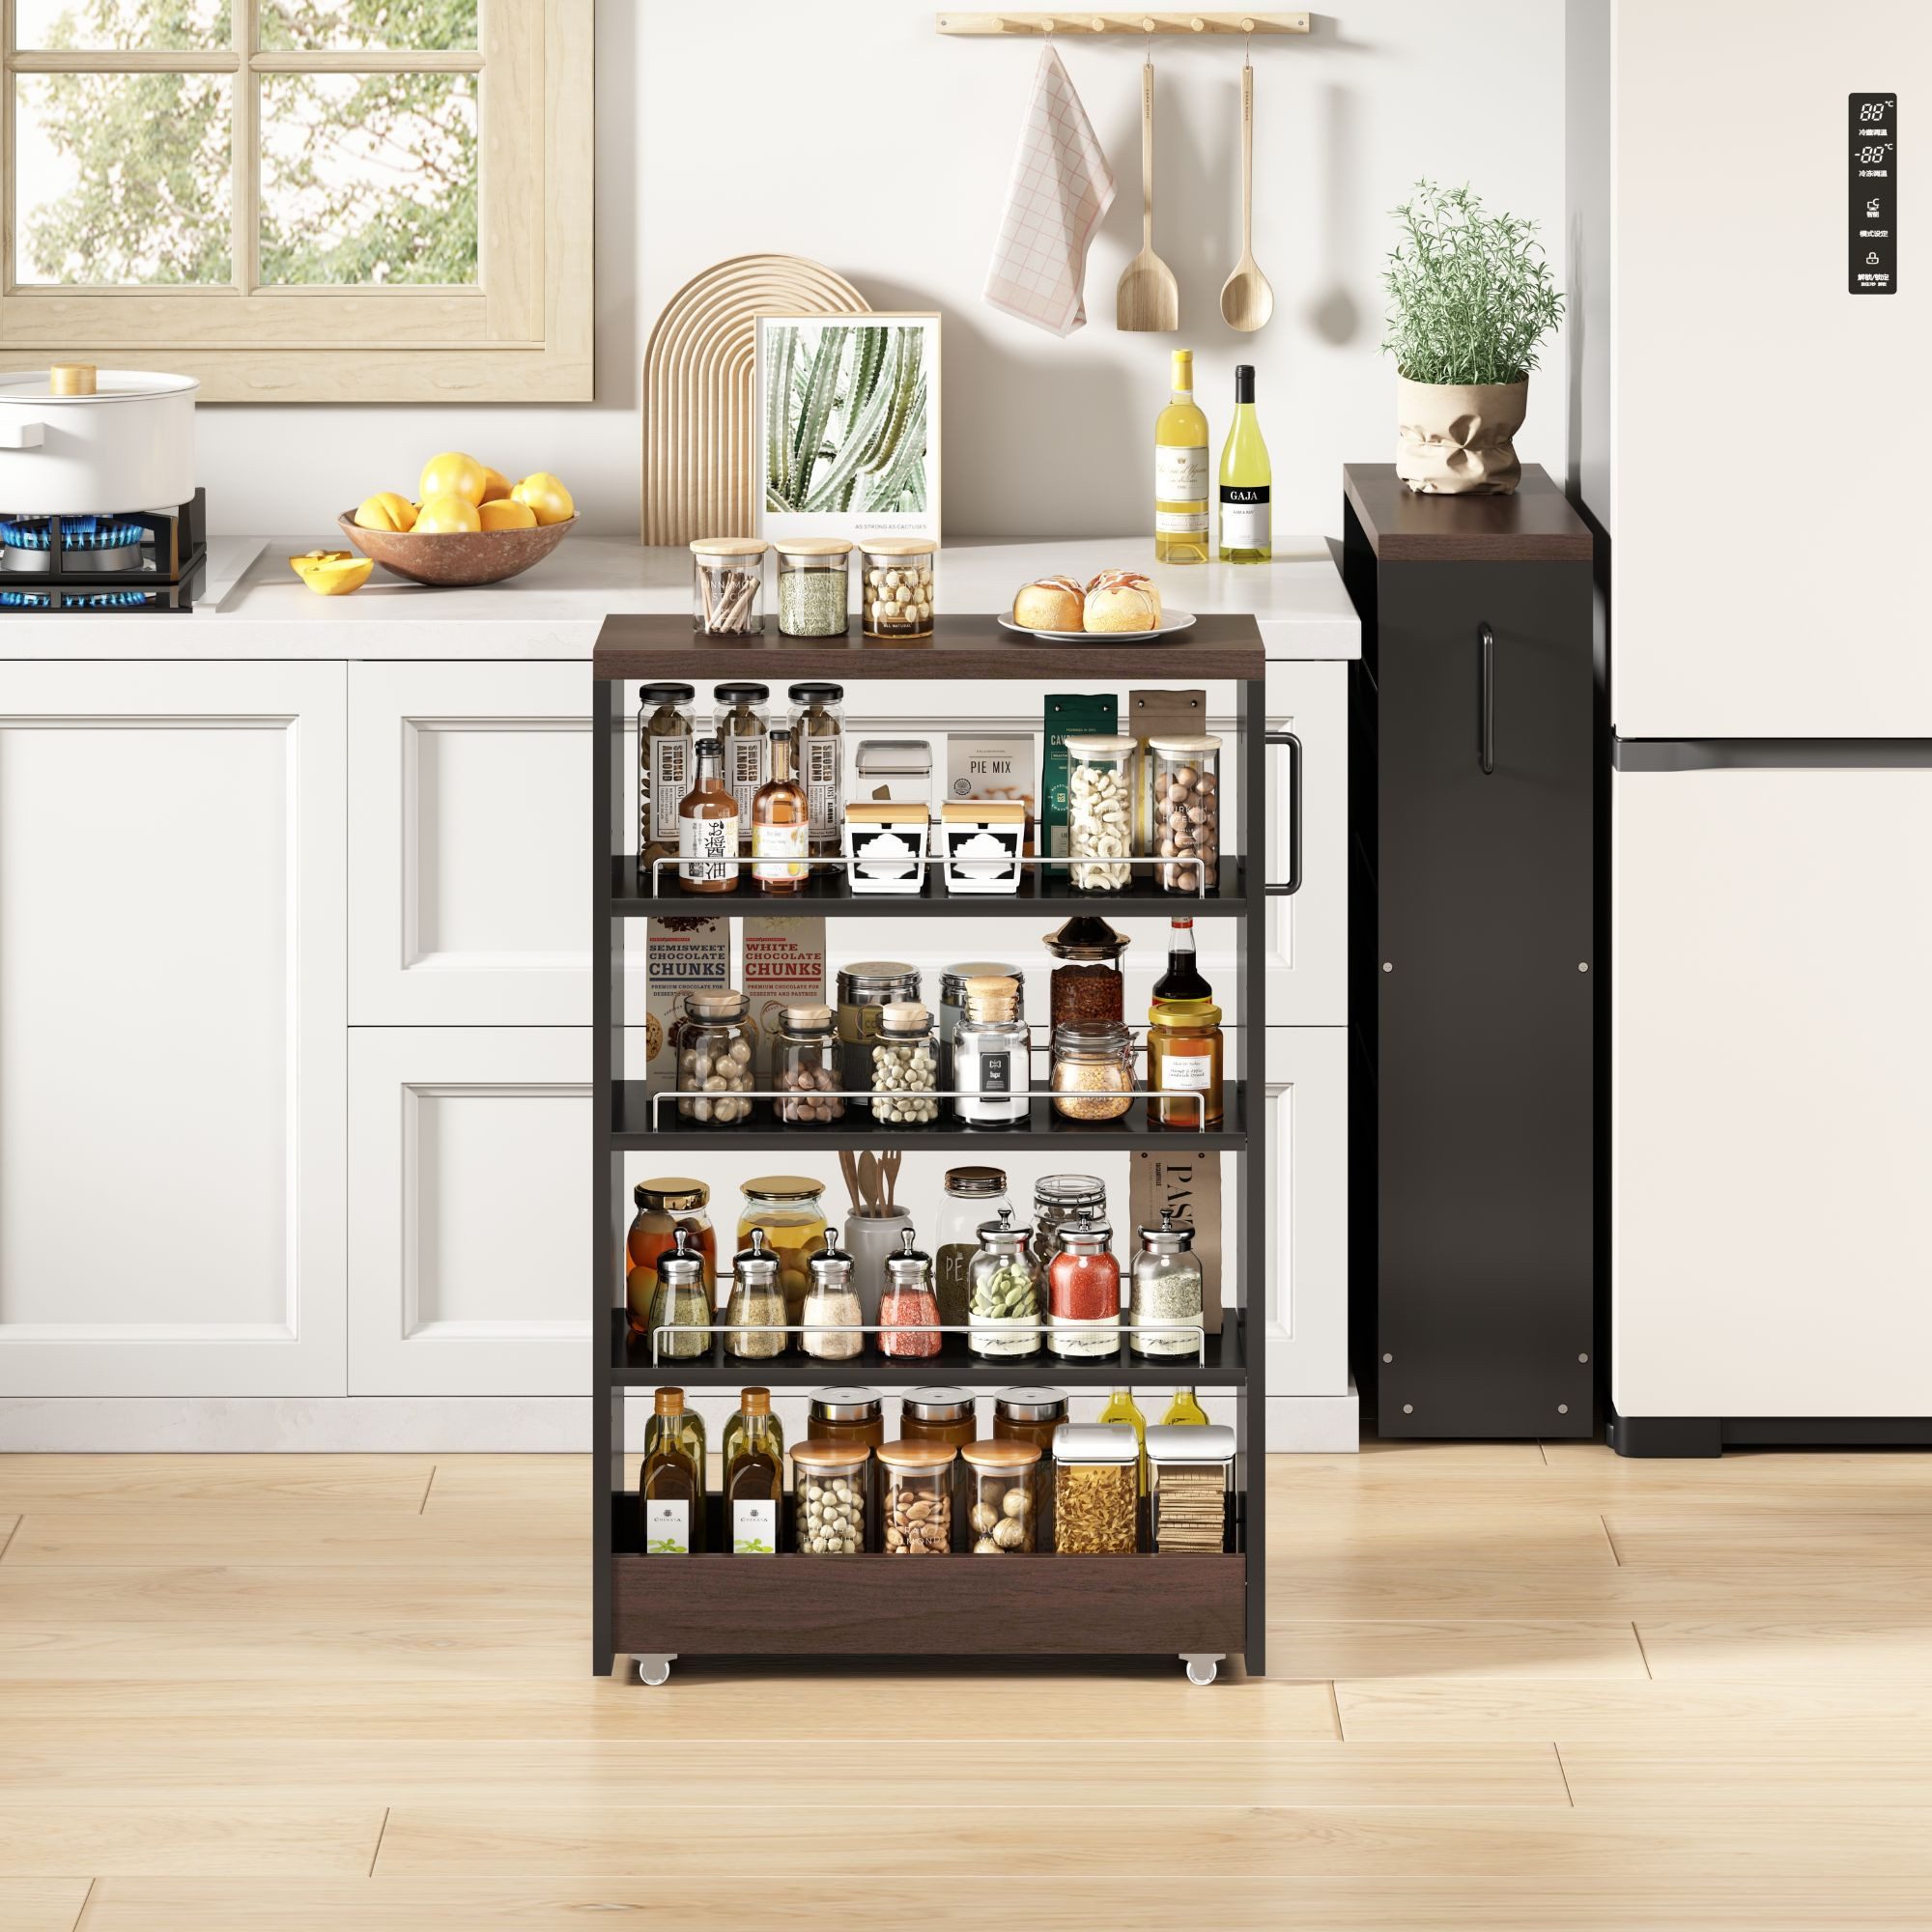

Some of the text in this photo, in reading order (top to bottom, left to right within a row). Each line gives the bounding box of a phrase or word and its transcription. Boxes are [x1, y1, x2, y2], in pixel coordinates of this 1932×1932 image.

[1230, 491, 1258, 500] GAJA
[662, 745, 672, 781] ALMOND
[673, 745, 683, 781] SMOKED
[736, 745, 748, 781] ALMOND
[748, 745, 757, 781] SMOKED
[811, 745, 822, 781] ALMOND
[822, 745, 833, 781] SMOKED
[971, 761, 1011, 774] PIE MIX
[746, 943, 798, 952] WHITE
[649, 962, 725, 976] CHUNKS
[746, 962, 822, 976] CHUNKS
